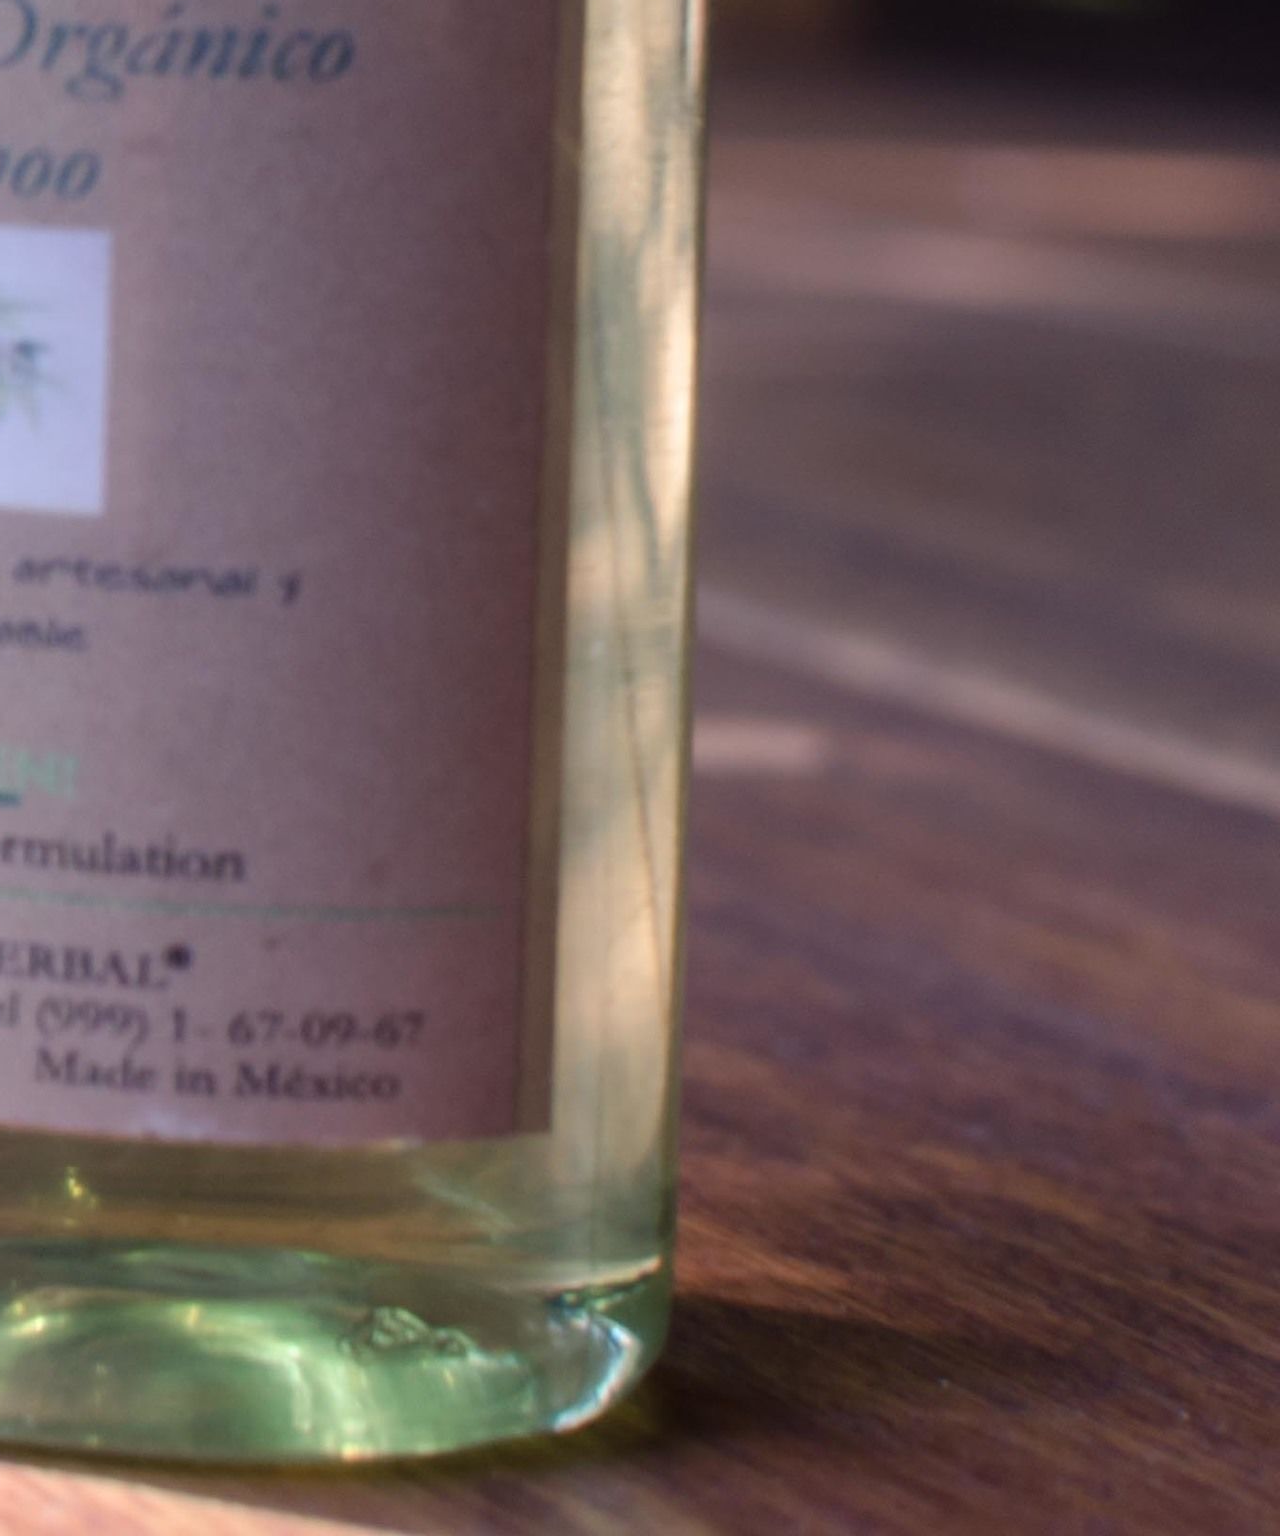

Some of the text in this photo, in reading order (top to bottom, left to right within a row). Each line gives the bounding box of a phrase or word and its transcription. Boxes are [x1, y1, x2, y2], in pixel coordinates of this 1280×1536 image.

[13, 554, 258, 598] artesanal
[34, 1044, 155, 1096] Made
[172, 1058, 218, 1097] in
[234, 1060, 402, 1100] México
